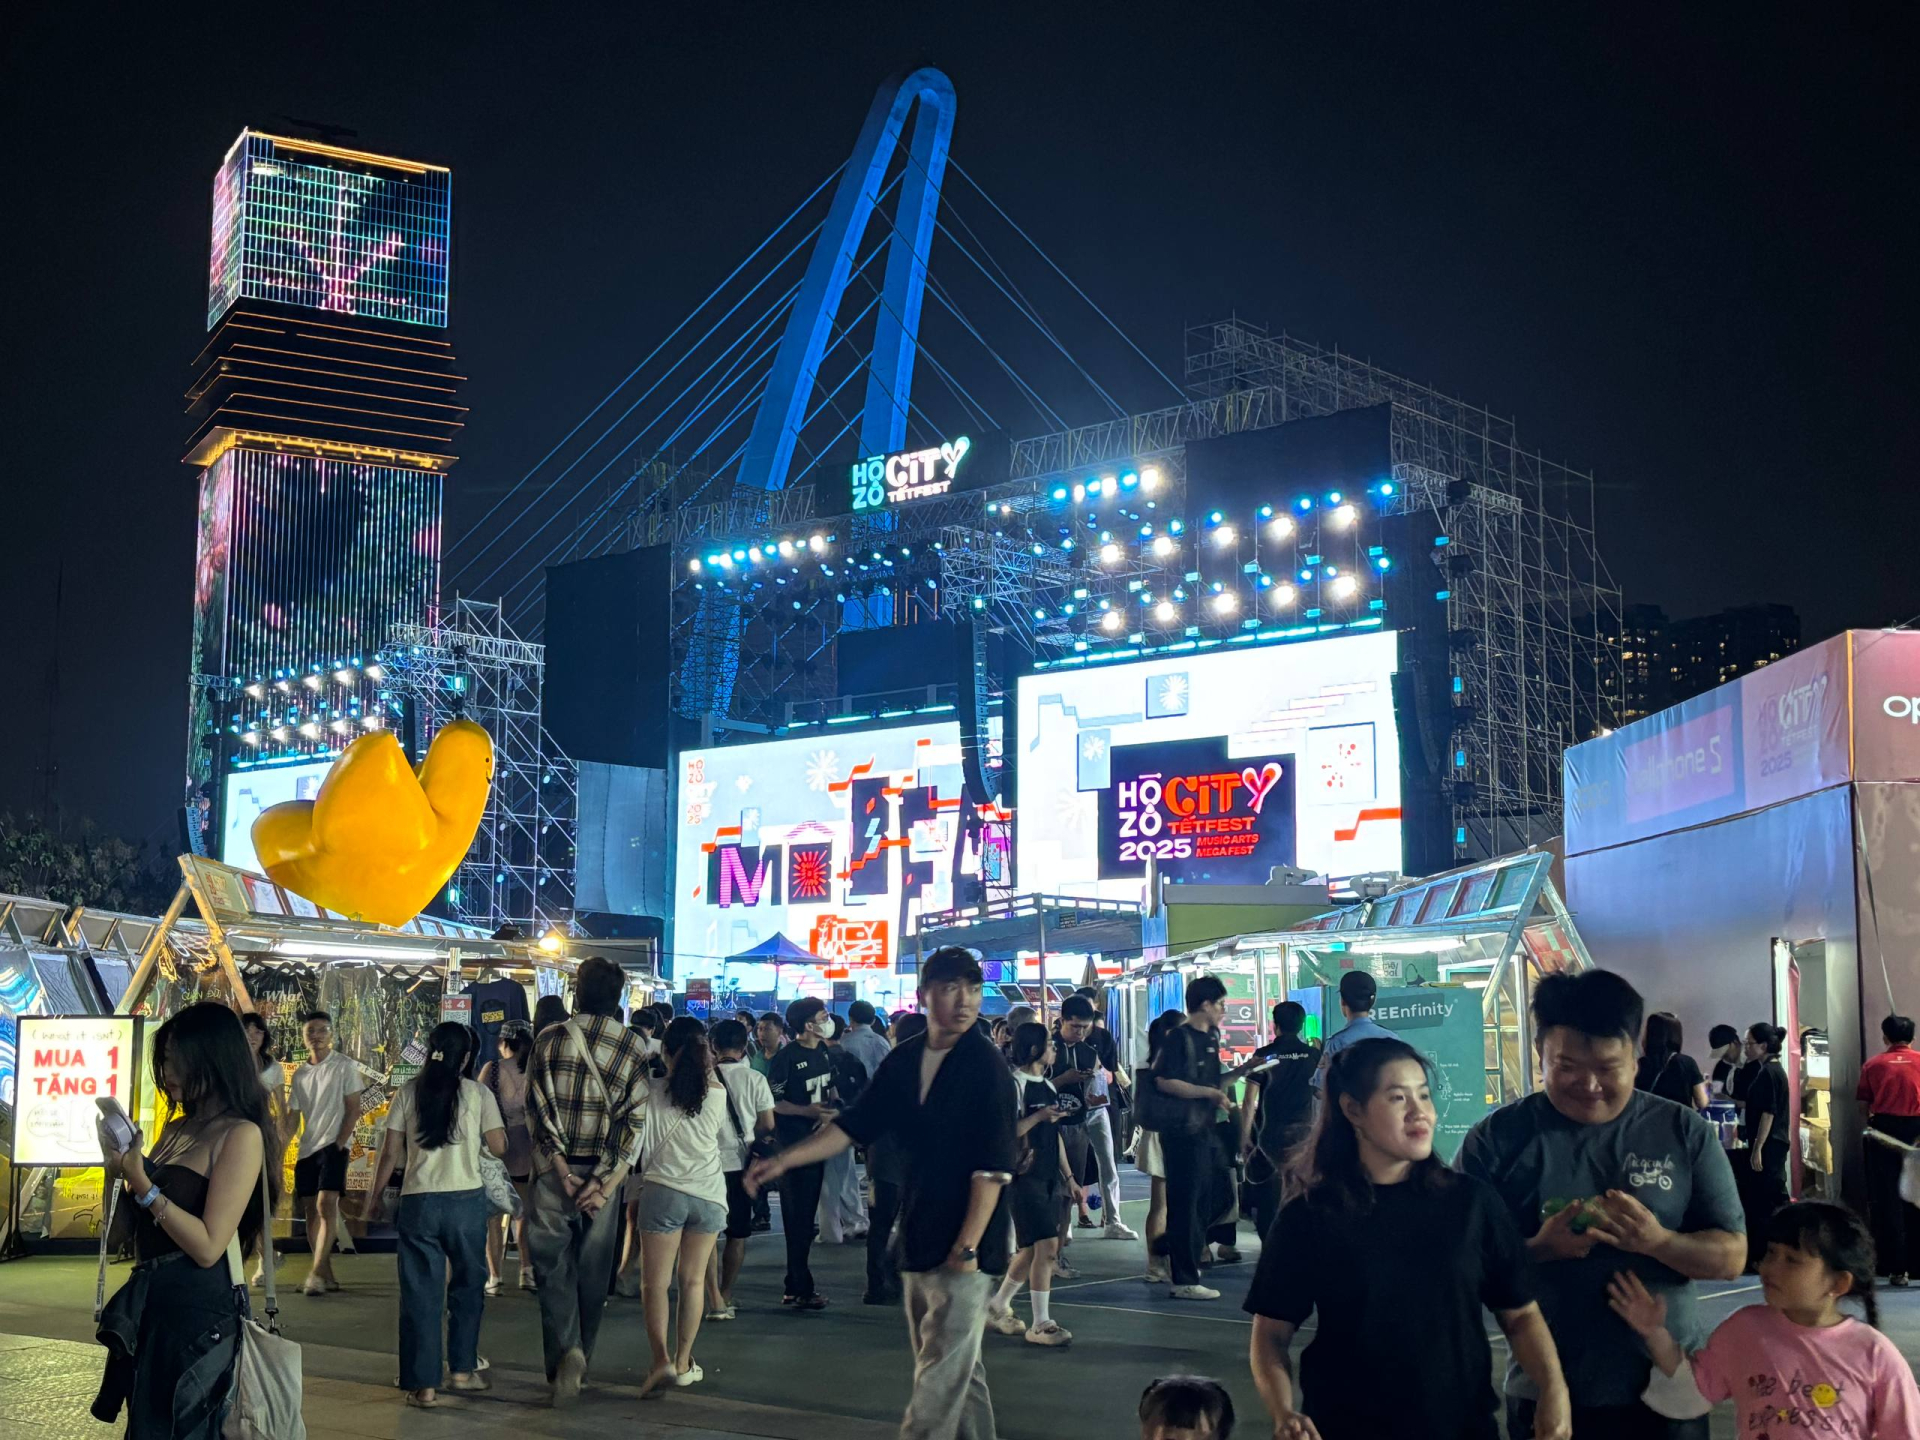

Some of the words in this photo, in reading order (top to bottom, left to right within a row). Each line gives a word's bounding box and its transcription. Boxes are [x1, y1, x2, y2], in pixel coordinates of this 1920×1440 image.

[1760, 751, 1793, 777] 2025
[1167, 815, 1256, 835] TẾTFEST
[1119, 838, 1192, 861] 2025
[1196, 835, 1231, 846] MUSIC
[1231, 833, 1260, 845] ARTS
[1196, 847, 1227, 858] MEGA
[1227, 845, 1255, 856] FEST
[457, 1001, 466, 1009] 4
[1239, 1006, 1252, 1019] G
[34, 1050, 85, 1067] MUA
[108, 1046, 119, 1069] 1
[33, 1073, 97, 1100] TẶNG
[105, 1074, 118, 1097] 1
